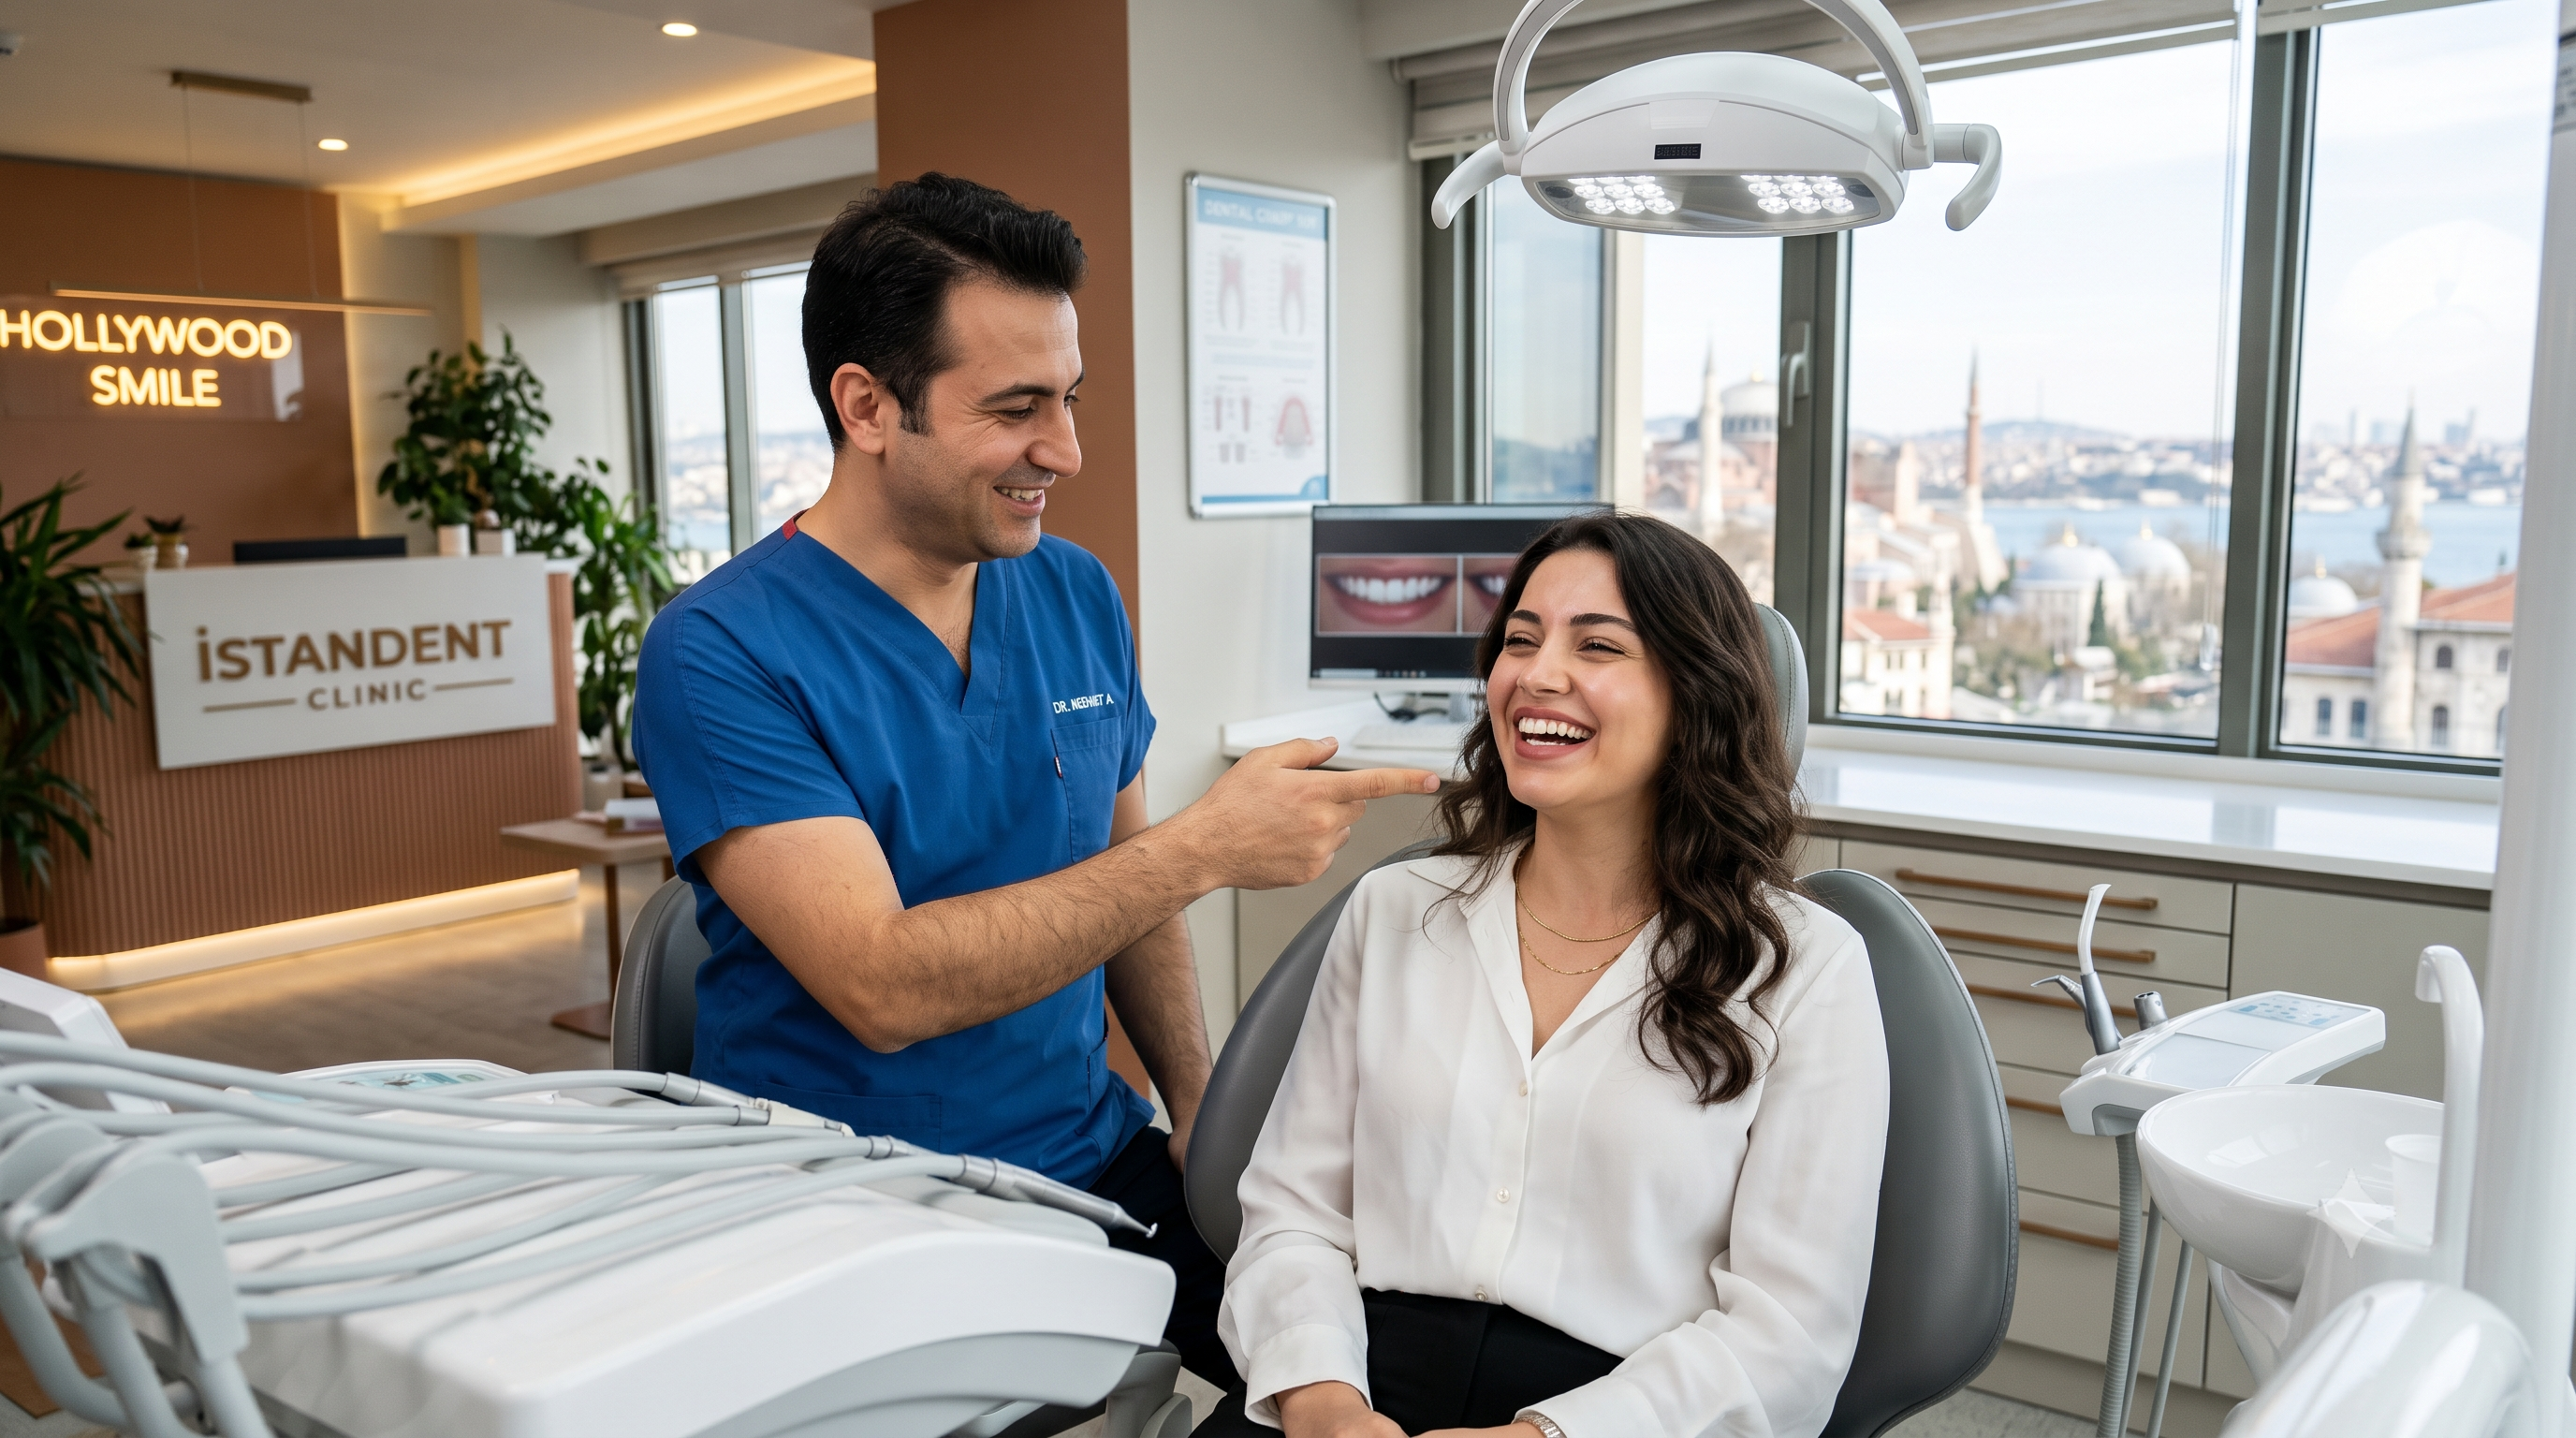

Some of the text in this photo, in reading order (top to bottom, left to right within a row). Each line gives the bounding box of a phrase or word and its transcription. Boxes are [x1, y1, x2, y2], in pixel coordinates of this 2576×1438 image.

[0, 309, 293, 360] HOLLYWOOD
[91, 364, 222, 407] SMILE
[307, 679, 427, 712] CLINIC
[1052, 701, 1071, 713] DR.
